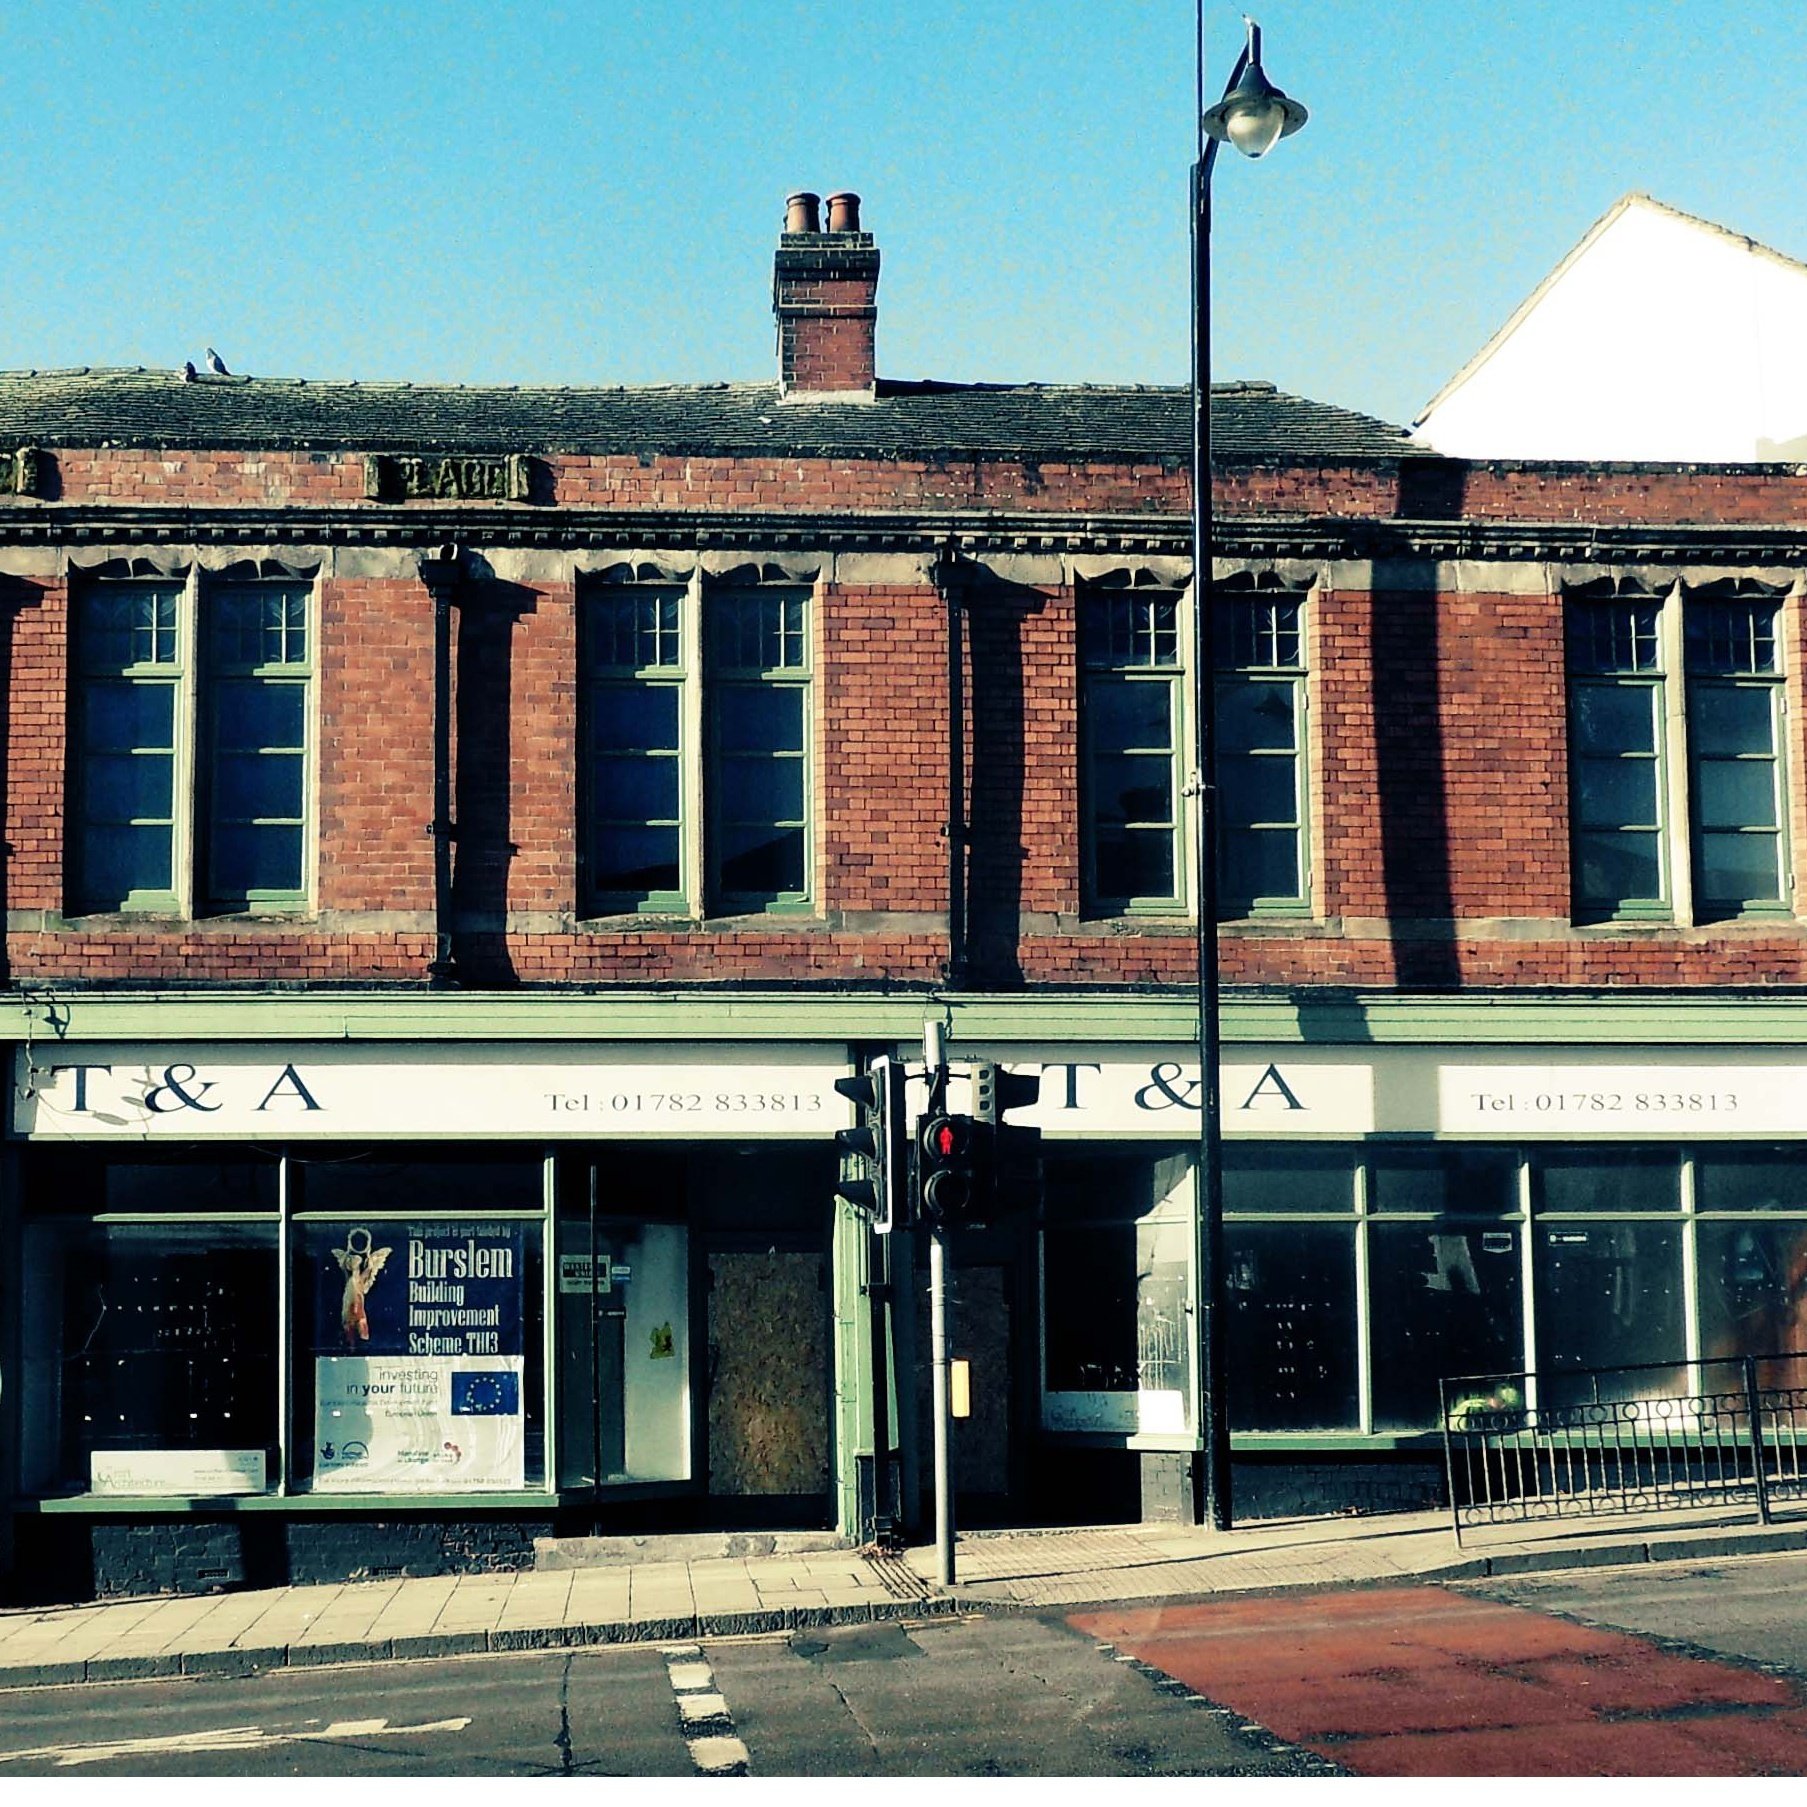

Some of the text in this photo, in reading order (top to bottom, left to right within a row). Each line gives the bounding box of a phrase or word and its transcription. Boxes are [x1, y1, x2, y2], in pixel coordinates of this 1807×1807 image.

[51, 1063, 328, 1113] T & A
[1041, 1062, 1311, 1110] T & A
[715, 1094, 823, 1112] 833813
[1635, 1094, 1738, 1111] 833813
[408, 1239, 513, 1279] Burslem
[409, 1280, 465, 1306] Building
[409, 1304, 499, 1330] Improvement
[409, 1332, 462, 1354] Scheme
[379, 1367, 438, 1382] investing
[346, 1381, 438, 1398] in your future
